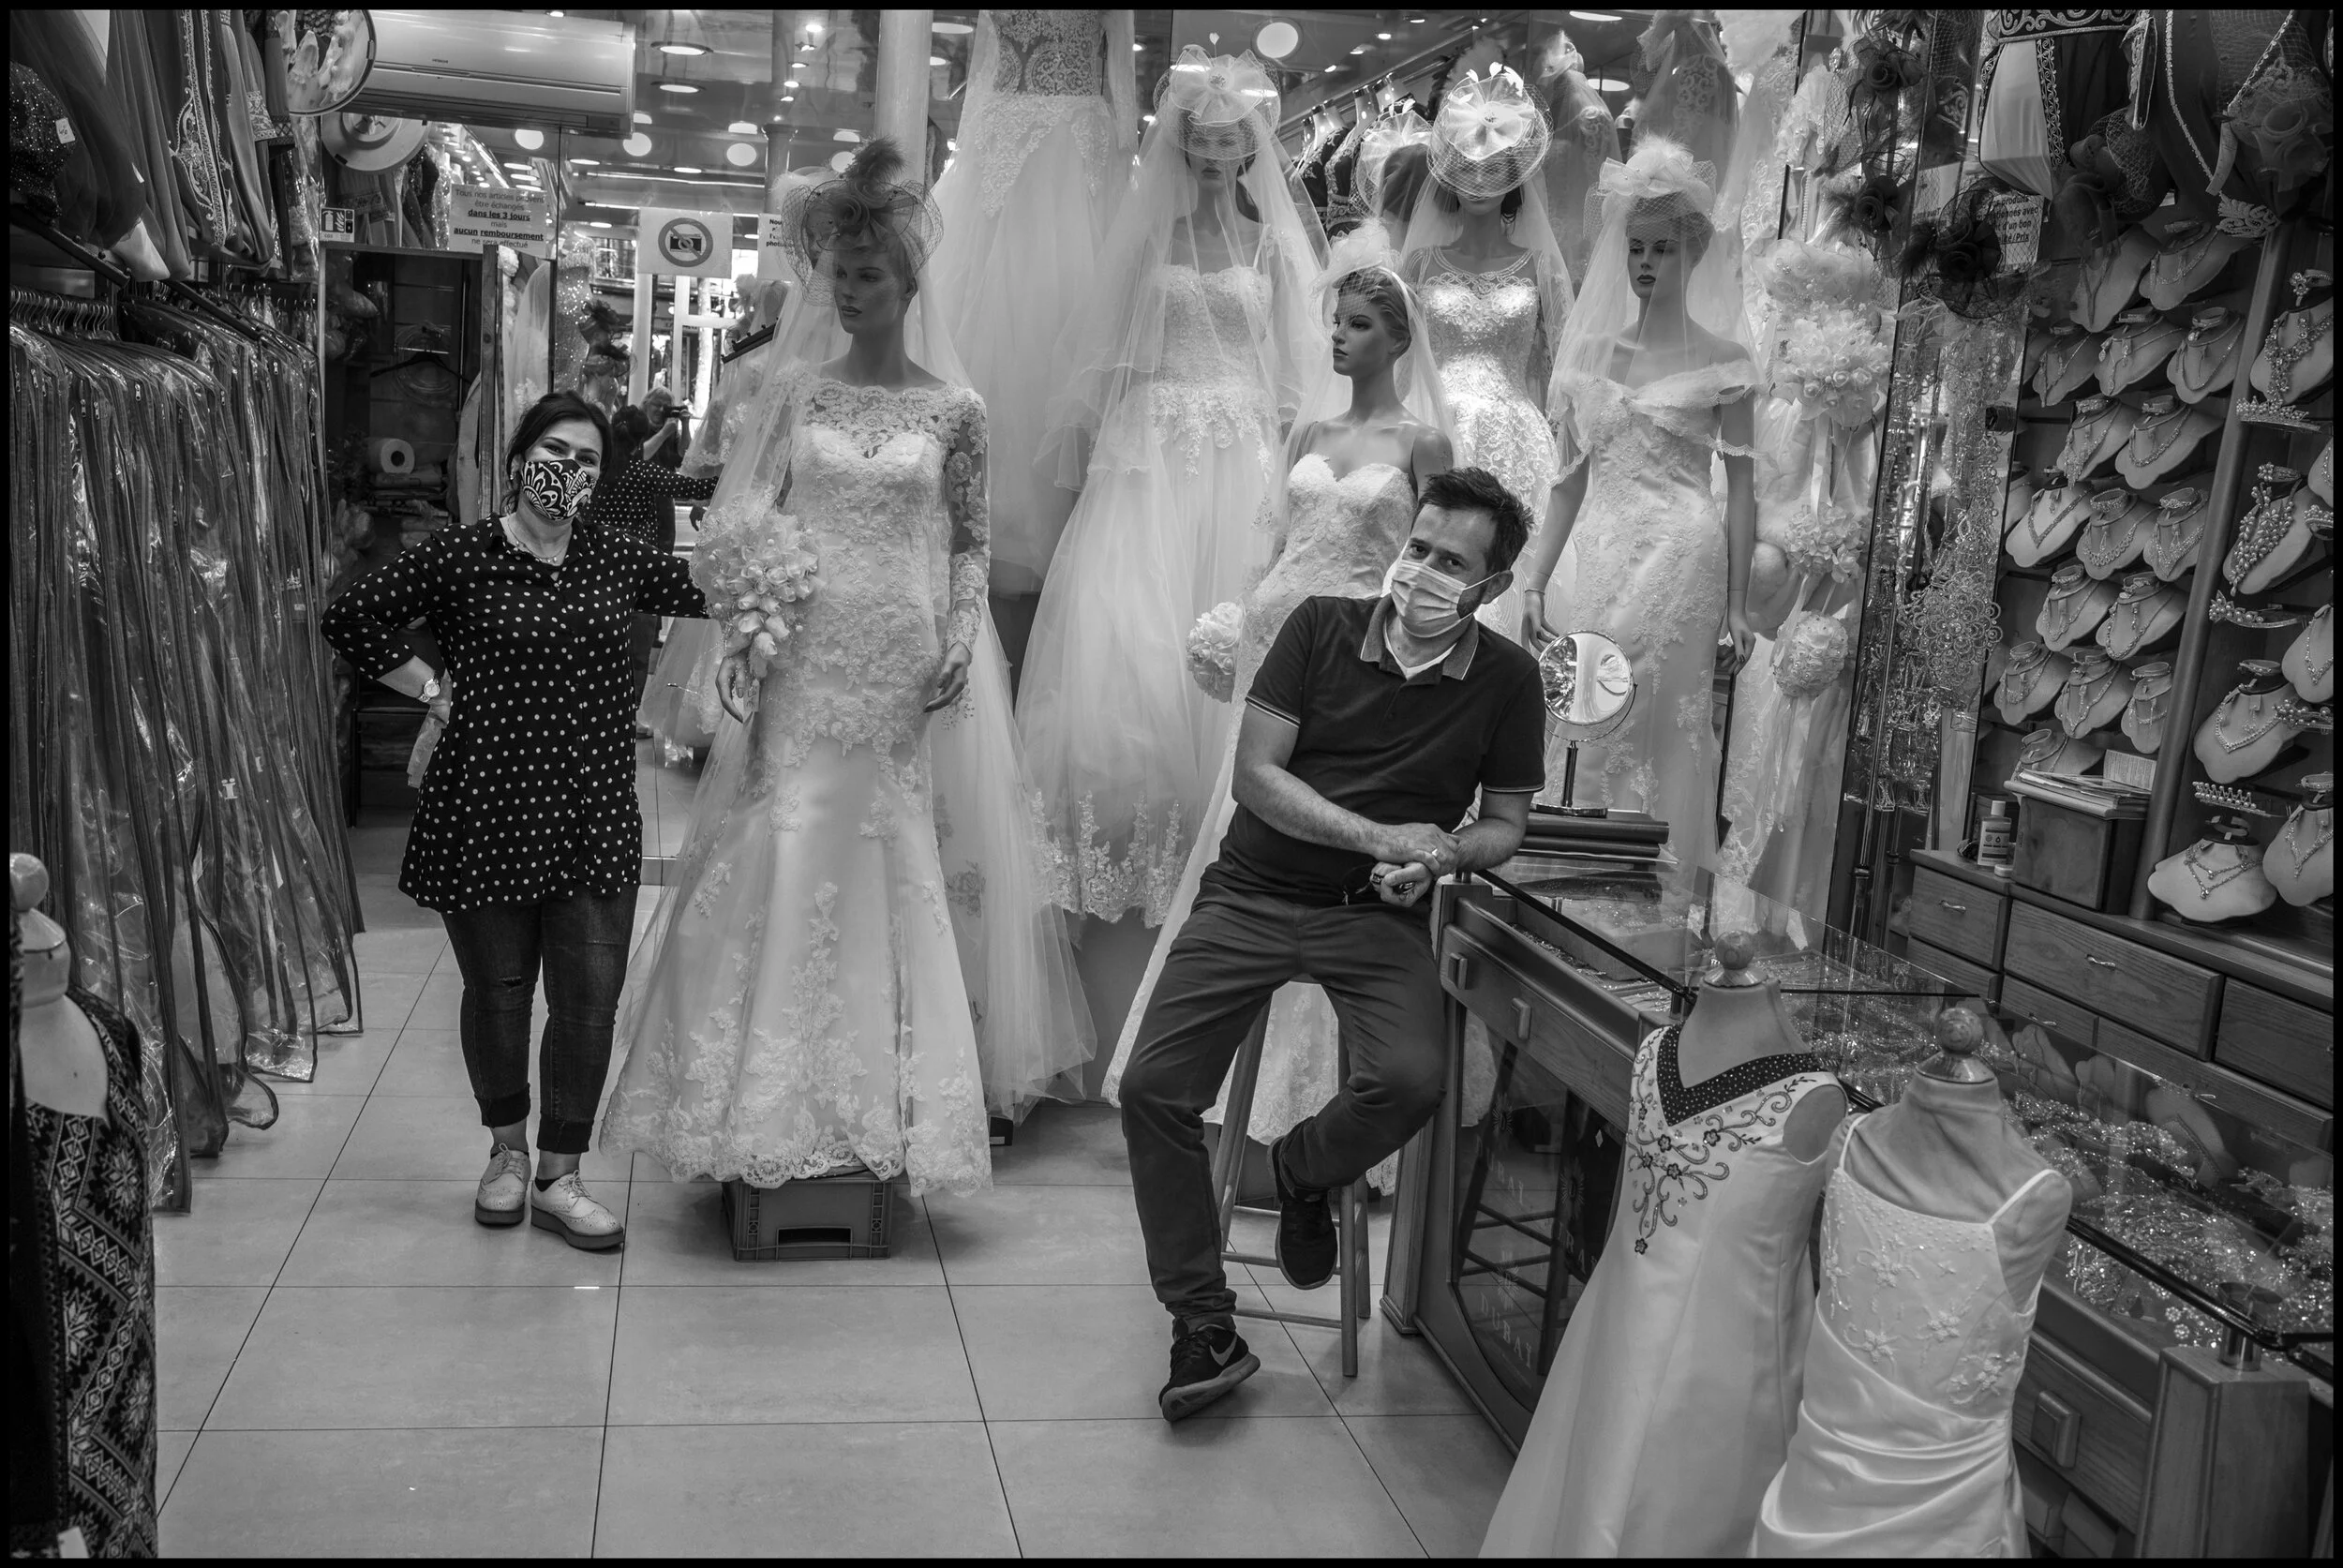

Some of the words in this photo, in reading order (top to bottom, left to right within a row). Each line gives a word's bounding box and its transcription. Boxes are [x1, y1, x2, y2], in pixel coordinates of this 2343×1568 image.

[468, 209, 486, 217] dans
[489, 210, 500, 218] les
[510, 212, 530, 221] jours
[454, 227, 478, 236] aucun
[480, 229, 544, 241] remboursement
